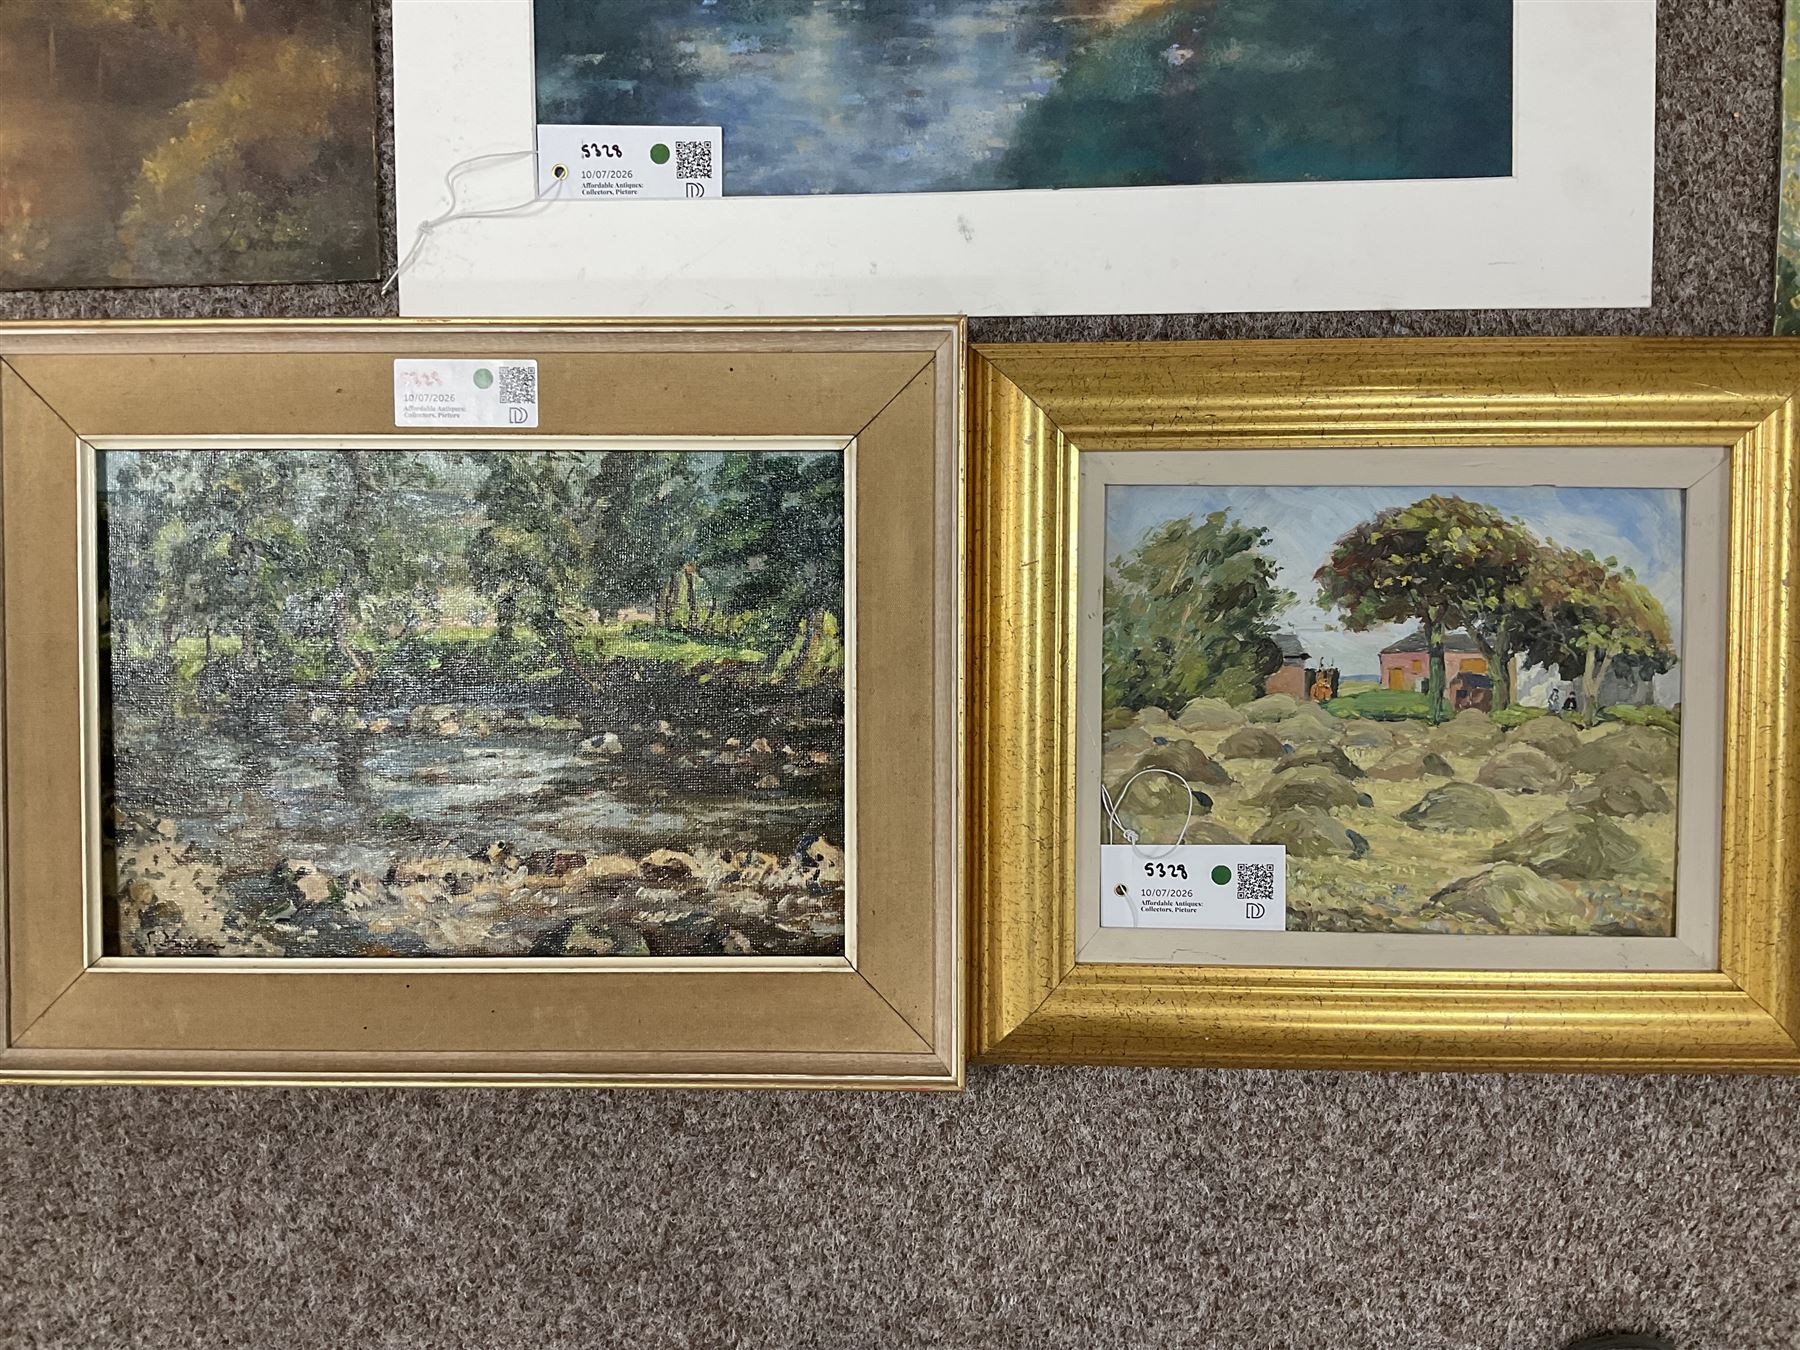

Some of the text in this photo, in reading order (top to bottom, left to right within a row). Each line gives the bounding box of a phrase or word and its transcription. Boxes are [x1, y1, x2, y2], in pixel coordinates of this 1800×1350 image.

[581, 143, 623, 158] 5328
[581, 170, 633, 179] 10/07/2026
[403, 393, 456, 402] 10/07/2026
[1144, 862, 1188, 880] 5328
[1141, 889, 1193, 897] 10/07/2026
